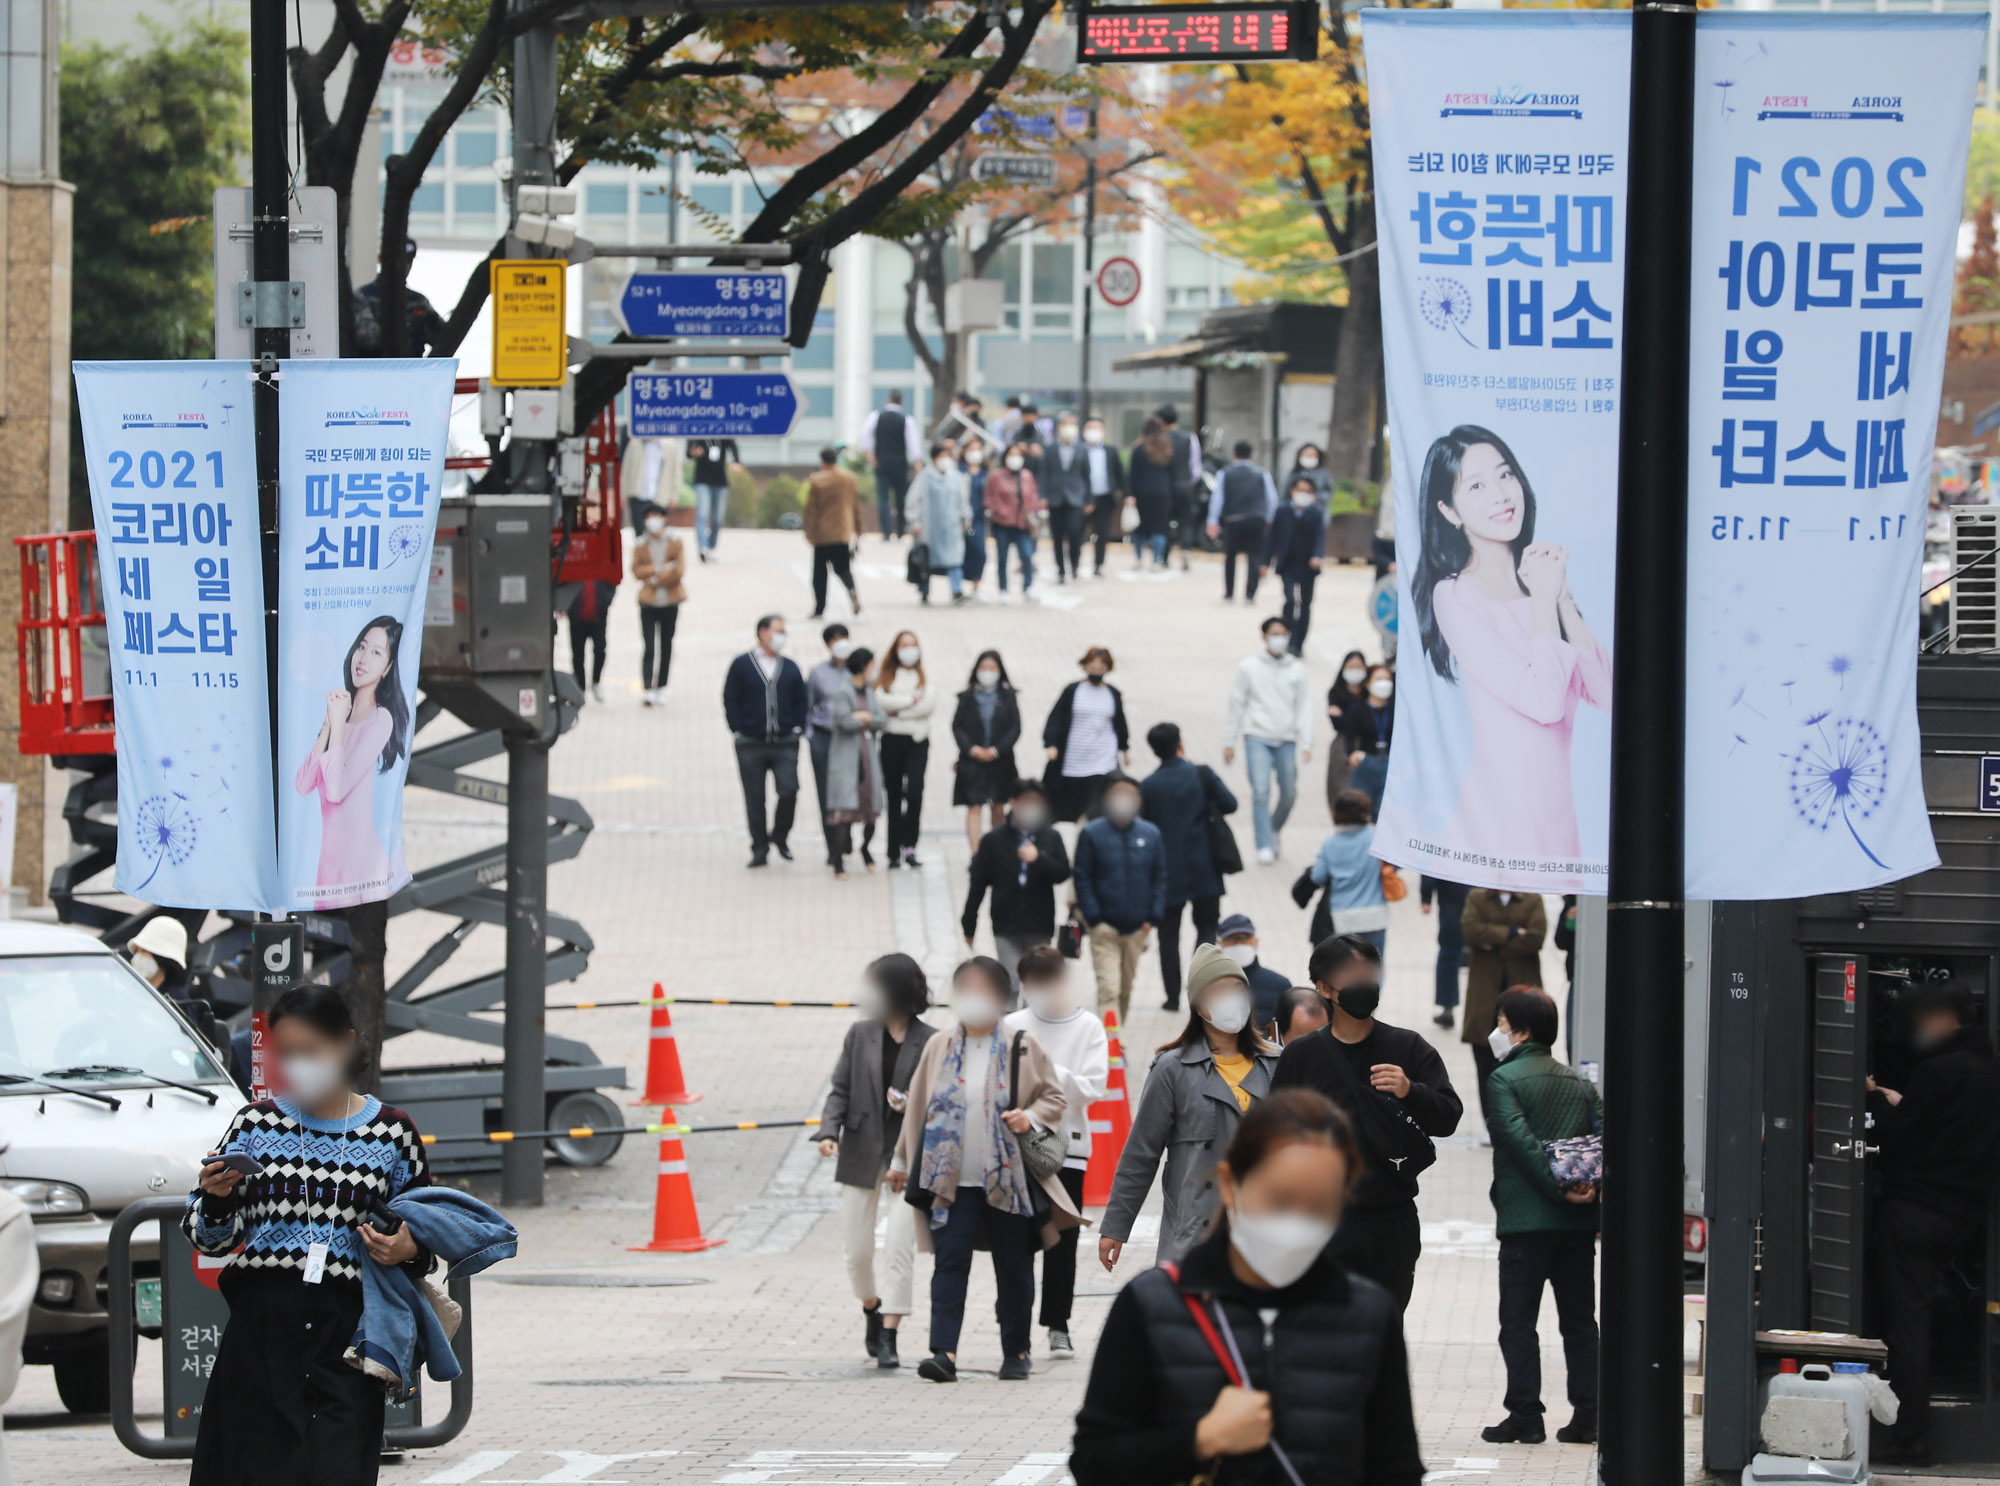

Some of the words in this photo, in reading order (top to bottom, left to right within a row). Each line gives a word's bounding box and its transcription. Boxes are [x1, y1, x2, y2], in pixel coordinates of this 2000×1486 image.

[716, 278, 783, 300] 명동9길
[657, 304, 747, 319] Myeongdong
[750, 304, 783, 319] 9-gil
[635, 378, 714, 400] 명동10길
[123, 413, 153, 421] KOREA
[178, 413, 206, 421] FESTA
[326, 411, 356, 419] KOREA
[381, 411, 409, 419] FESTA
[635, 404, 725, 419] Myeongdong
[729, 403, 768, 419] 10-gil
[305, 449, 327, 462] 국민
[330, 448, 376, 462] 모두에게
[380, 448, 404, 461] 힘이
[408, 448, 432, 461] 되는
[108, 450, 224, 489] 2021
[305, 471, 430, 519] 따뜻한
[112, 502, 232, 546] 코리아
[305, 525, 379, 570] 소비
[118, 557, 151, 601] 세
[194, 557, 231, 602] 일
[123, 611, 237, 656] 페스타
[125, 669, 157, 687] 11.1
[192, 672, 239, 688] 11.15
[263, 975, 291, 986] 서울중구
[1731, 972, 1744, 984] TG
